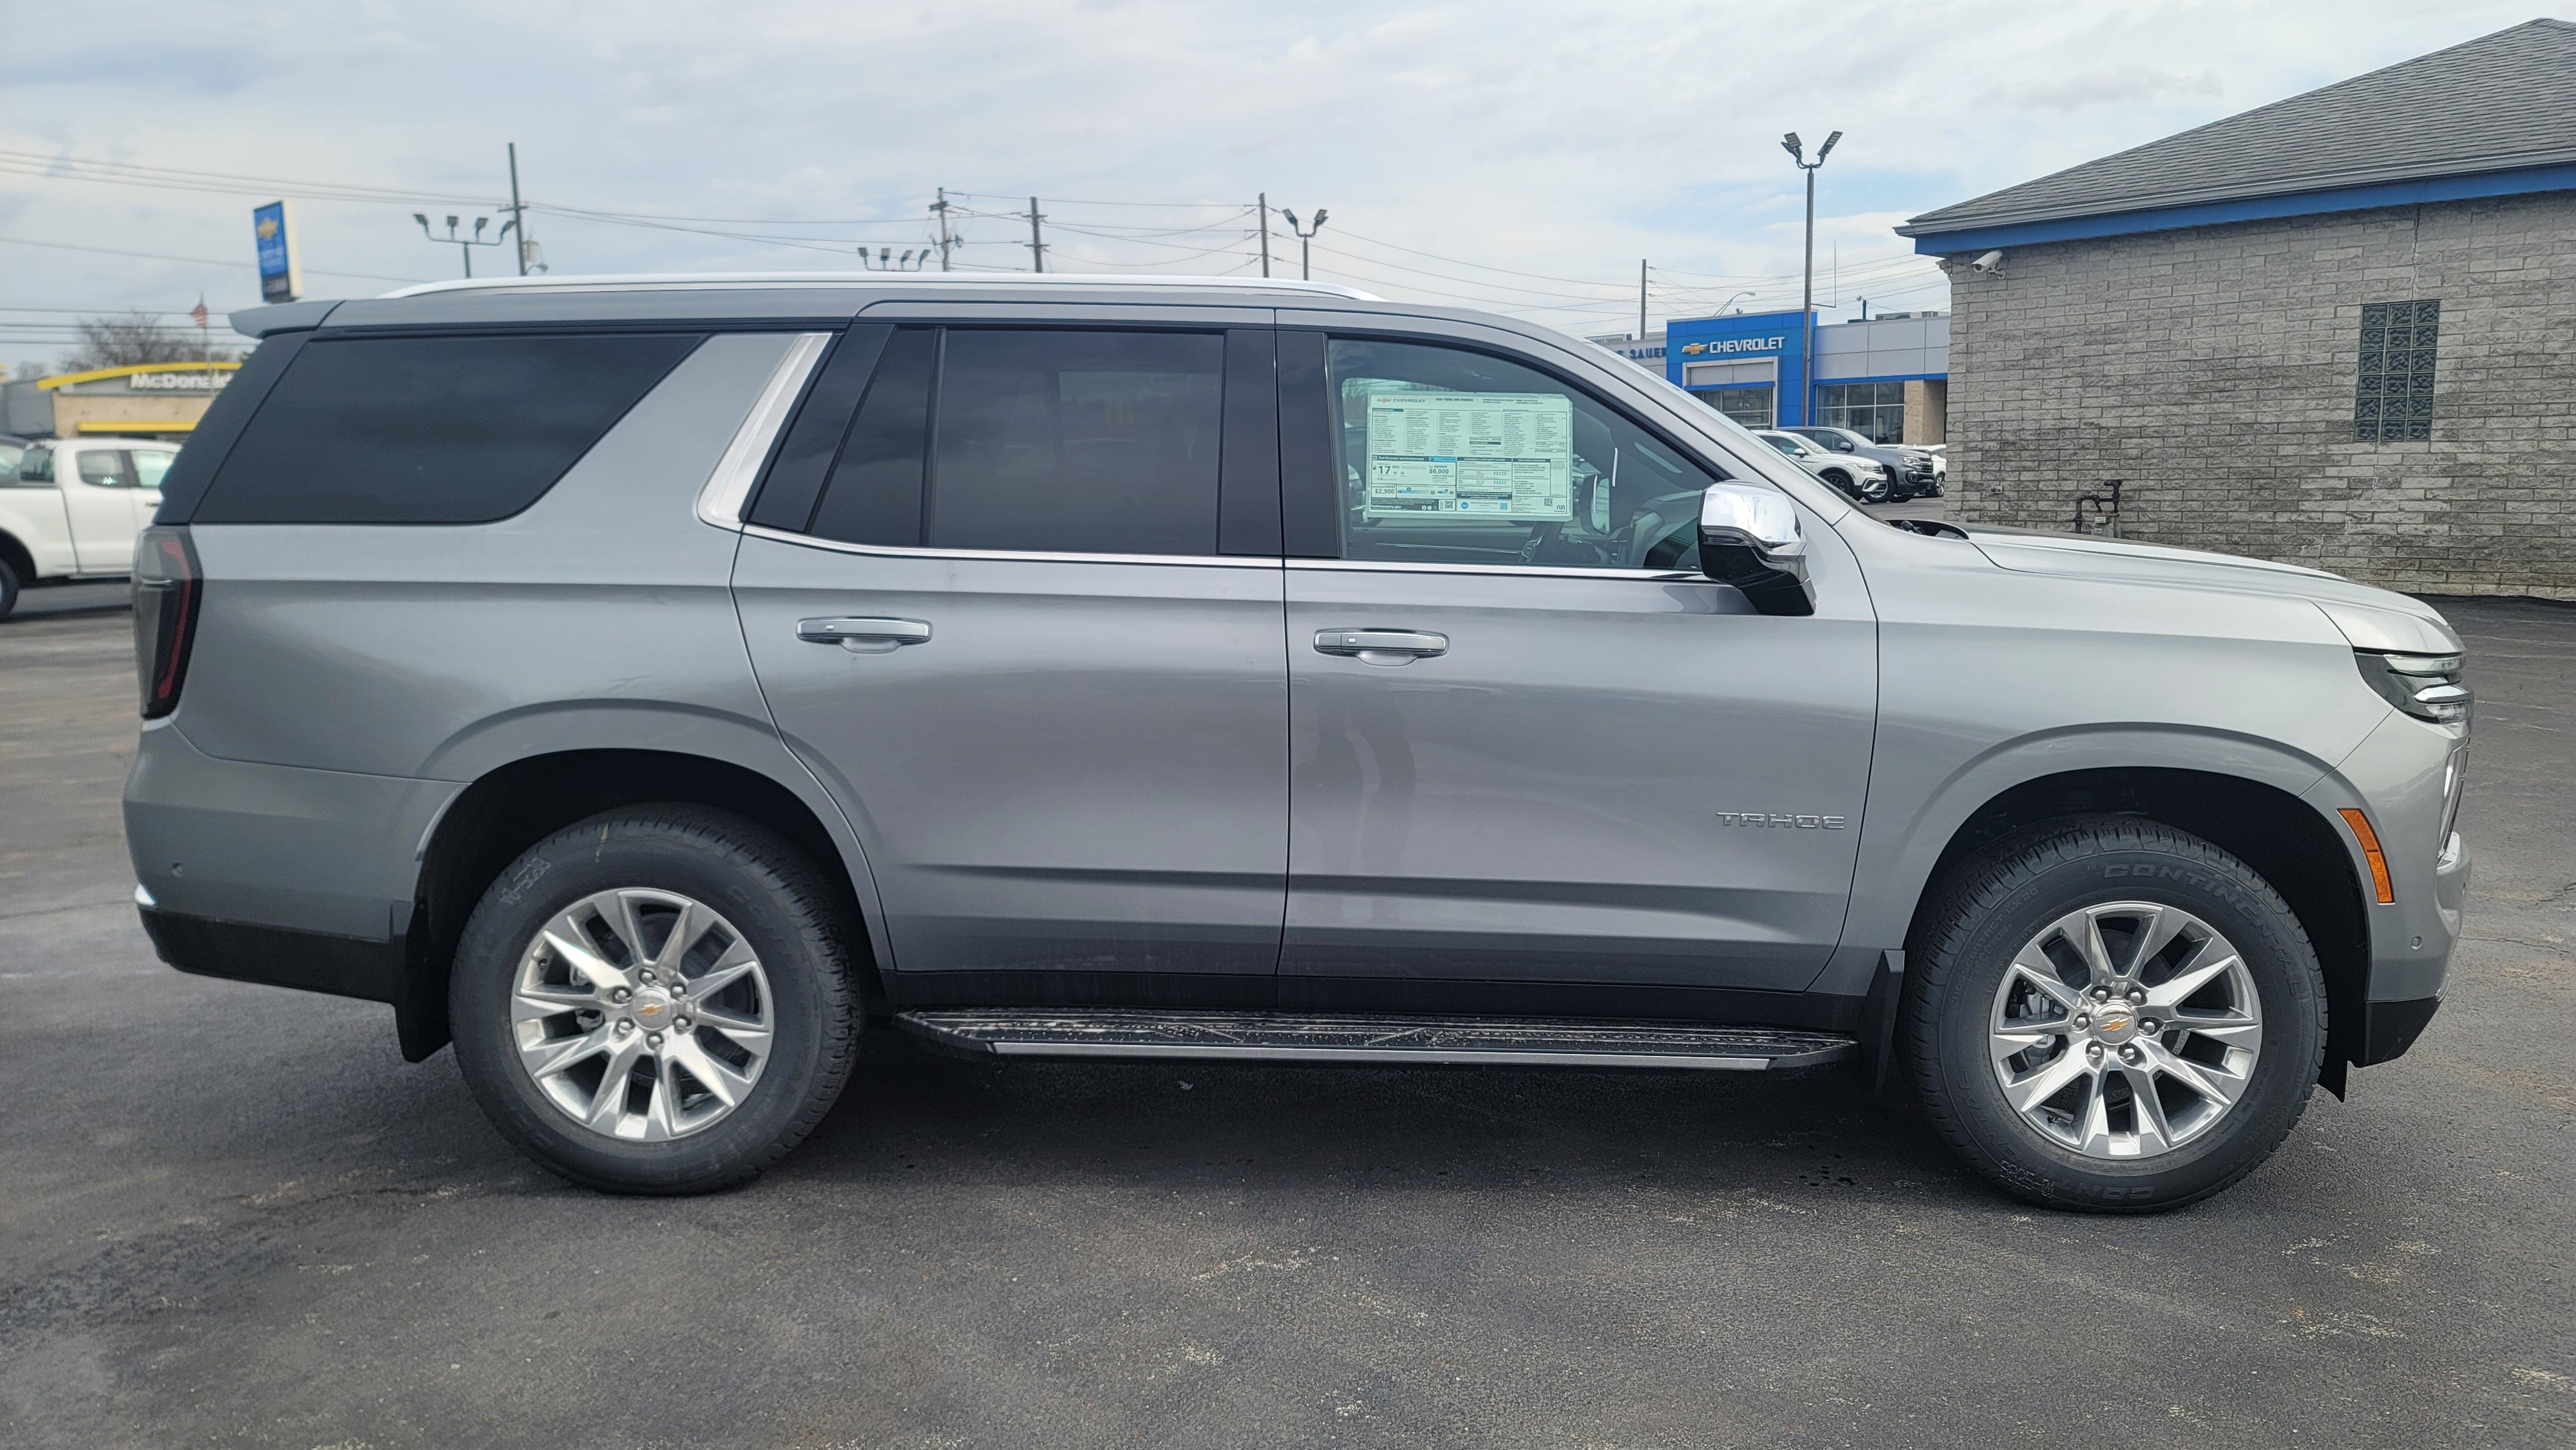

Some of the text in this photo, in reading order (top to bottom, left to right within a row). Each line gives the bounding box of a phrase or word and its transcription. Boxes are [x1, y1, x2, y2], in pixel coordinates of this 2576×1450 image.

[1709, 336, 1786, 353] CHEVROLET
[1378, 466, 1391, 475] 17
[1716, 812, 1845, 829] TAHOE
[2104, 863, 2301, 997] CONTINENTAL
